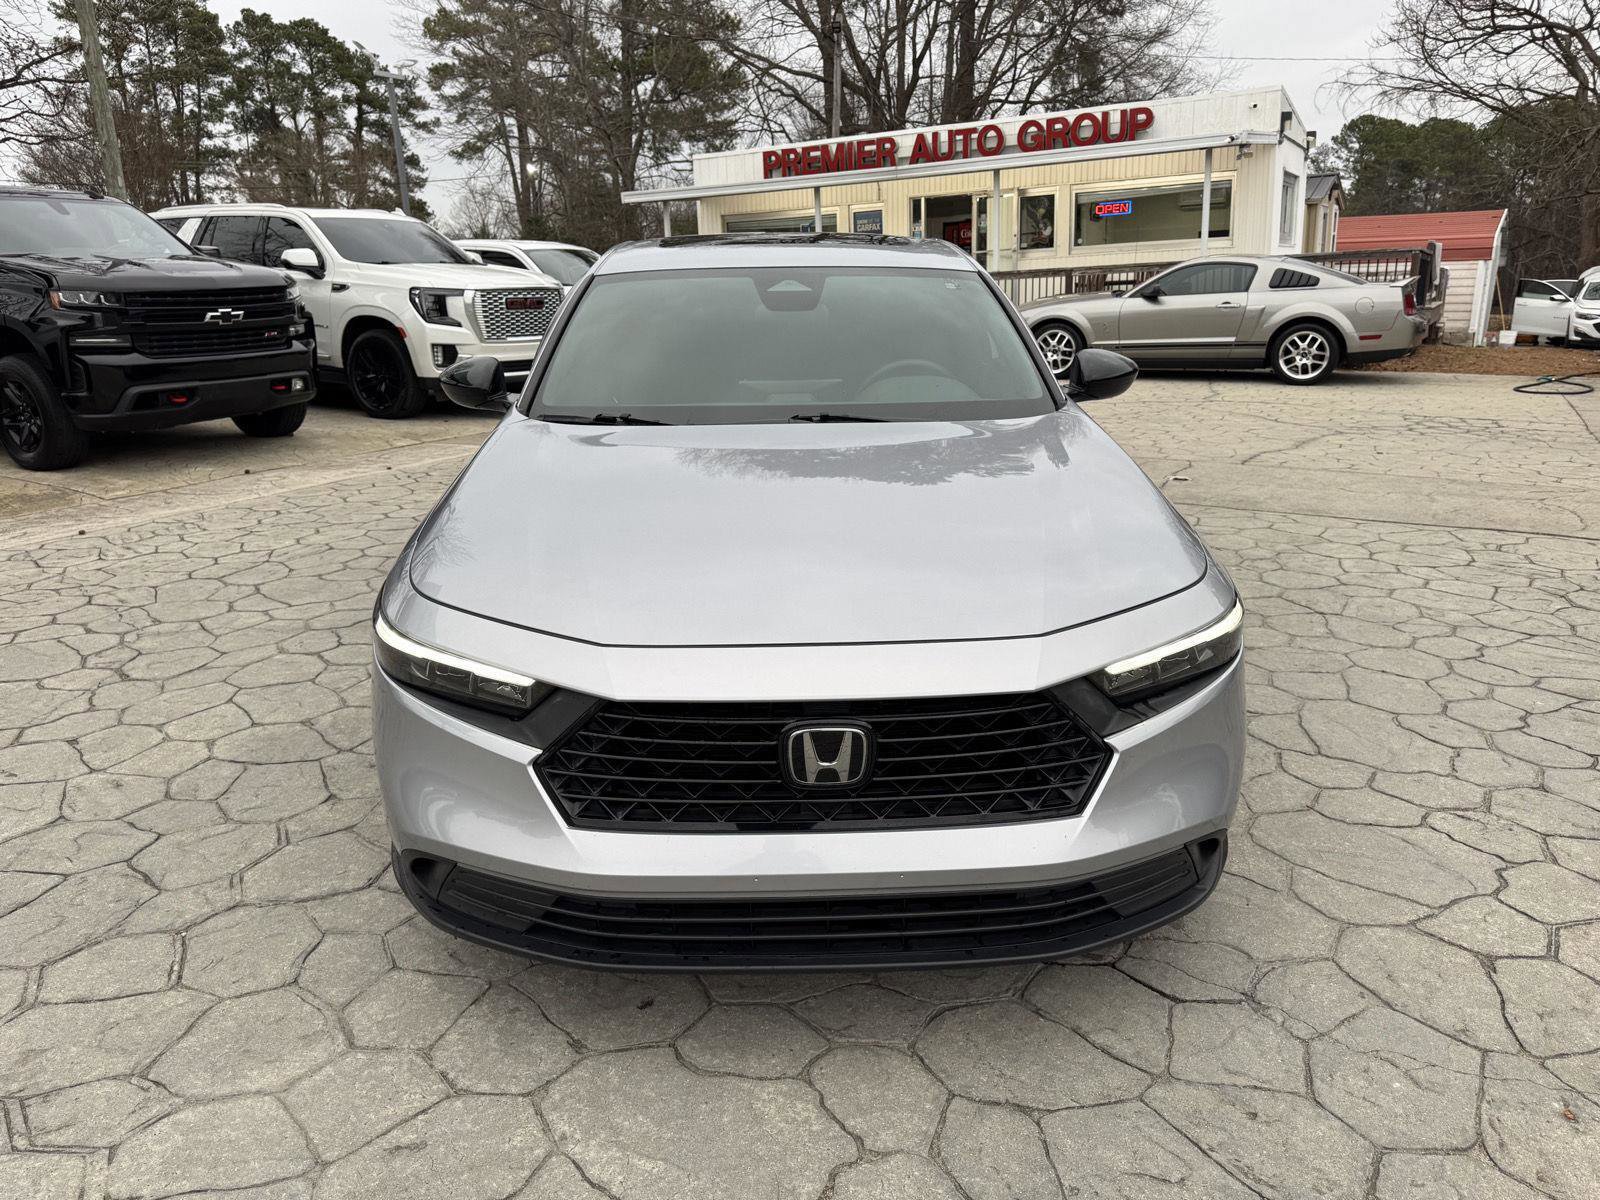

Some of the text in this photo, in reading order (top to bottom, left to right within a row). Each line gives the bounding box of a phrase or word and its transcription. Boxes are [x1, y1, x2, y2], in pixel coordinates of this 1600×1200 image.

[762, 106, 1155, 179] PREMIER AUTO GROUP
[1095, 203, 1129, 215] OPEN
[856, 223, 881, 231] CARFAX
